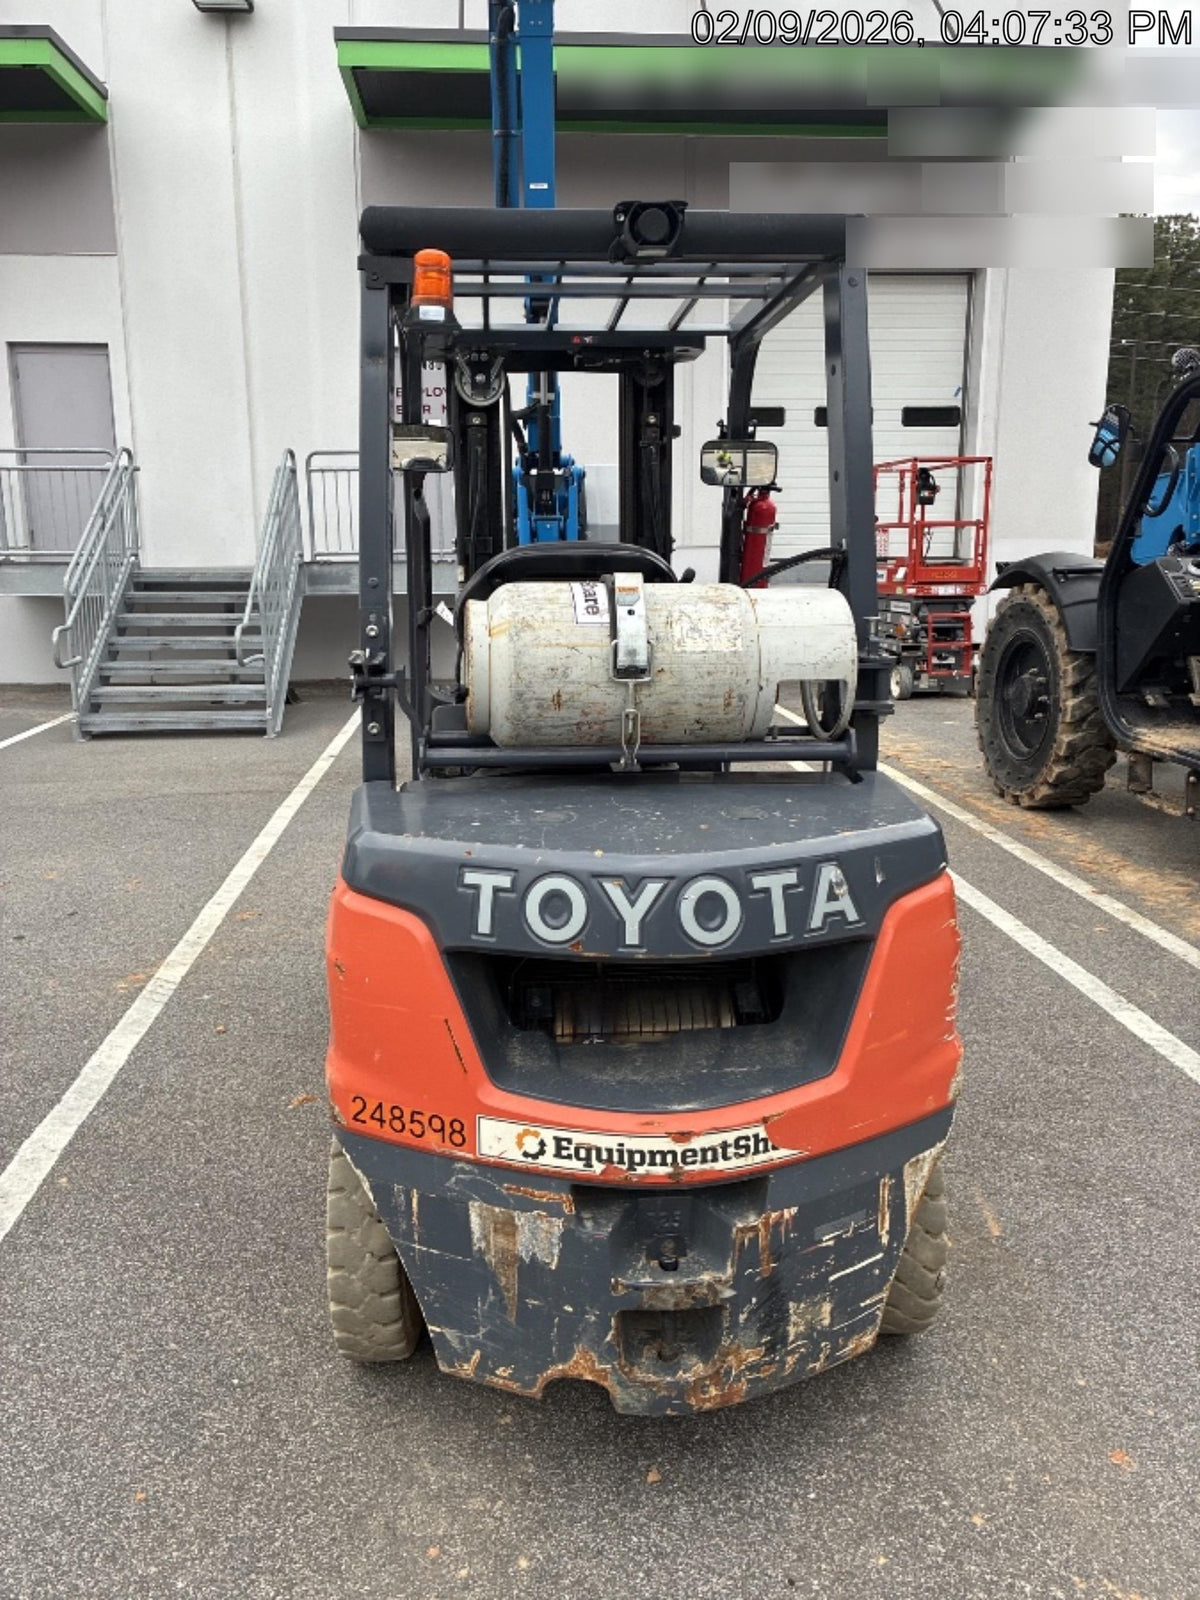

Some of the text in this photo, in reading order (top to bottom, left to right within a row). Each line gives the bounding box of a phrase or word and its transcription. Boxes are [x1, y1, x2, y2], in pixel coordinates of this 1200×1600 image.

[462, 862, 860, 946] TOYOTA
[351, 1095, 467, 1147] 248598
[552, 1132, 780, 1171] EquipmentSh
